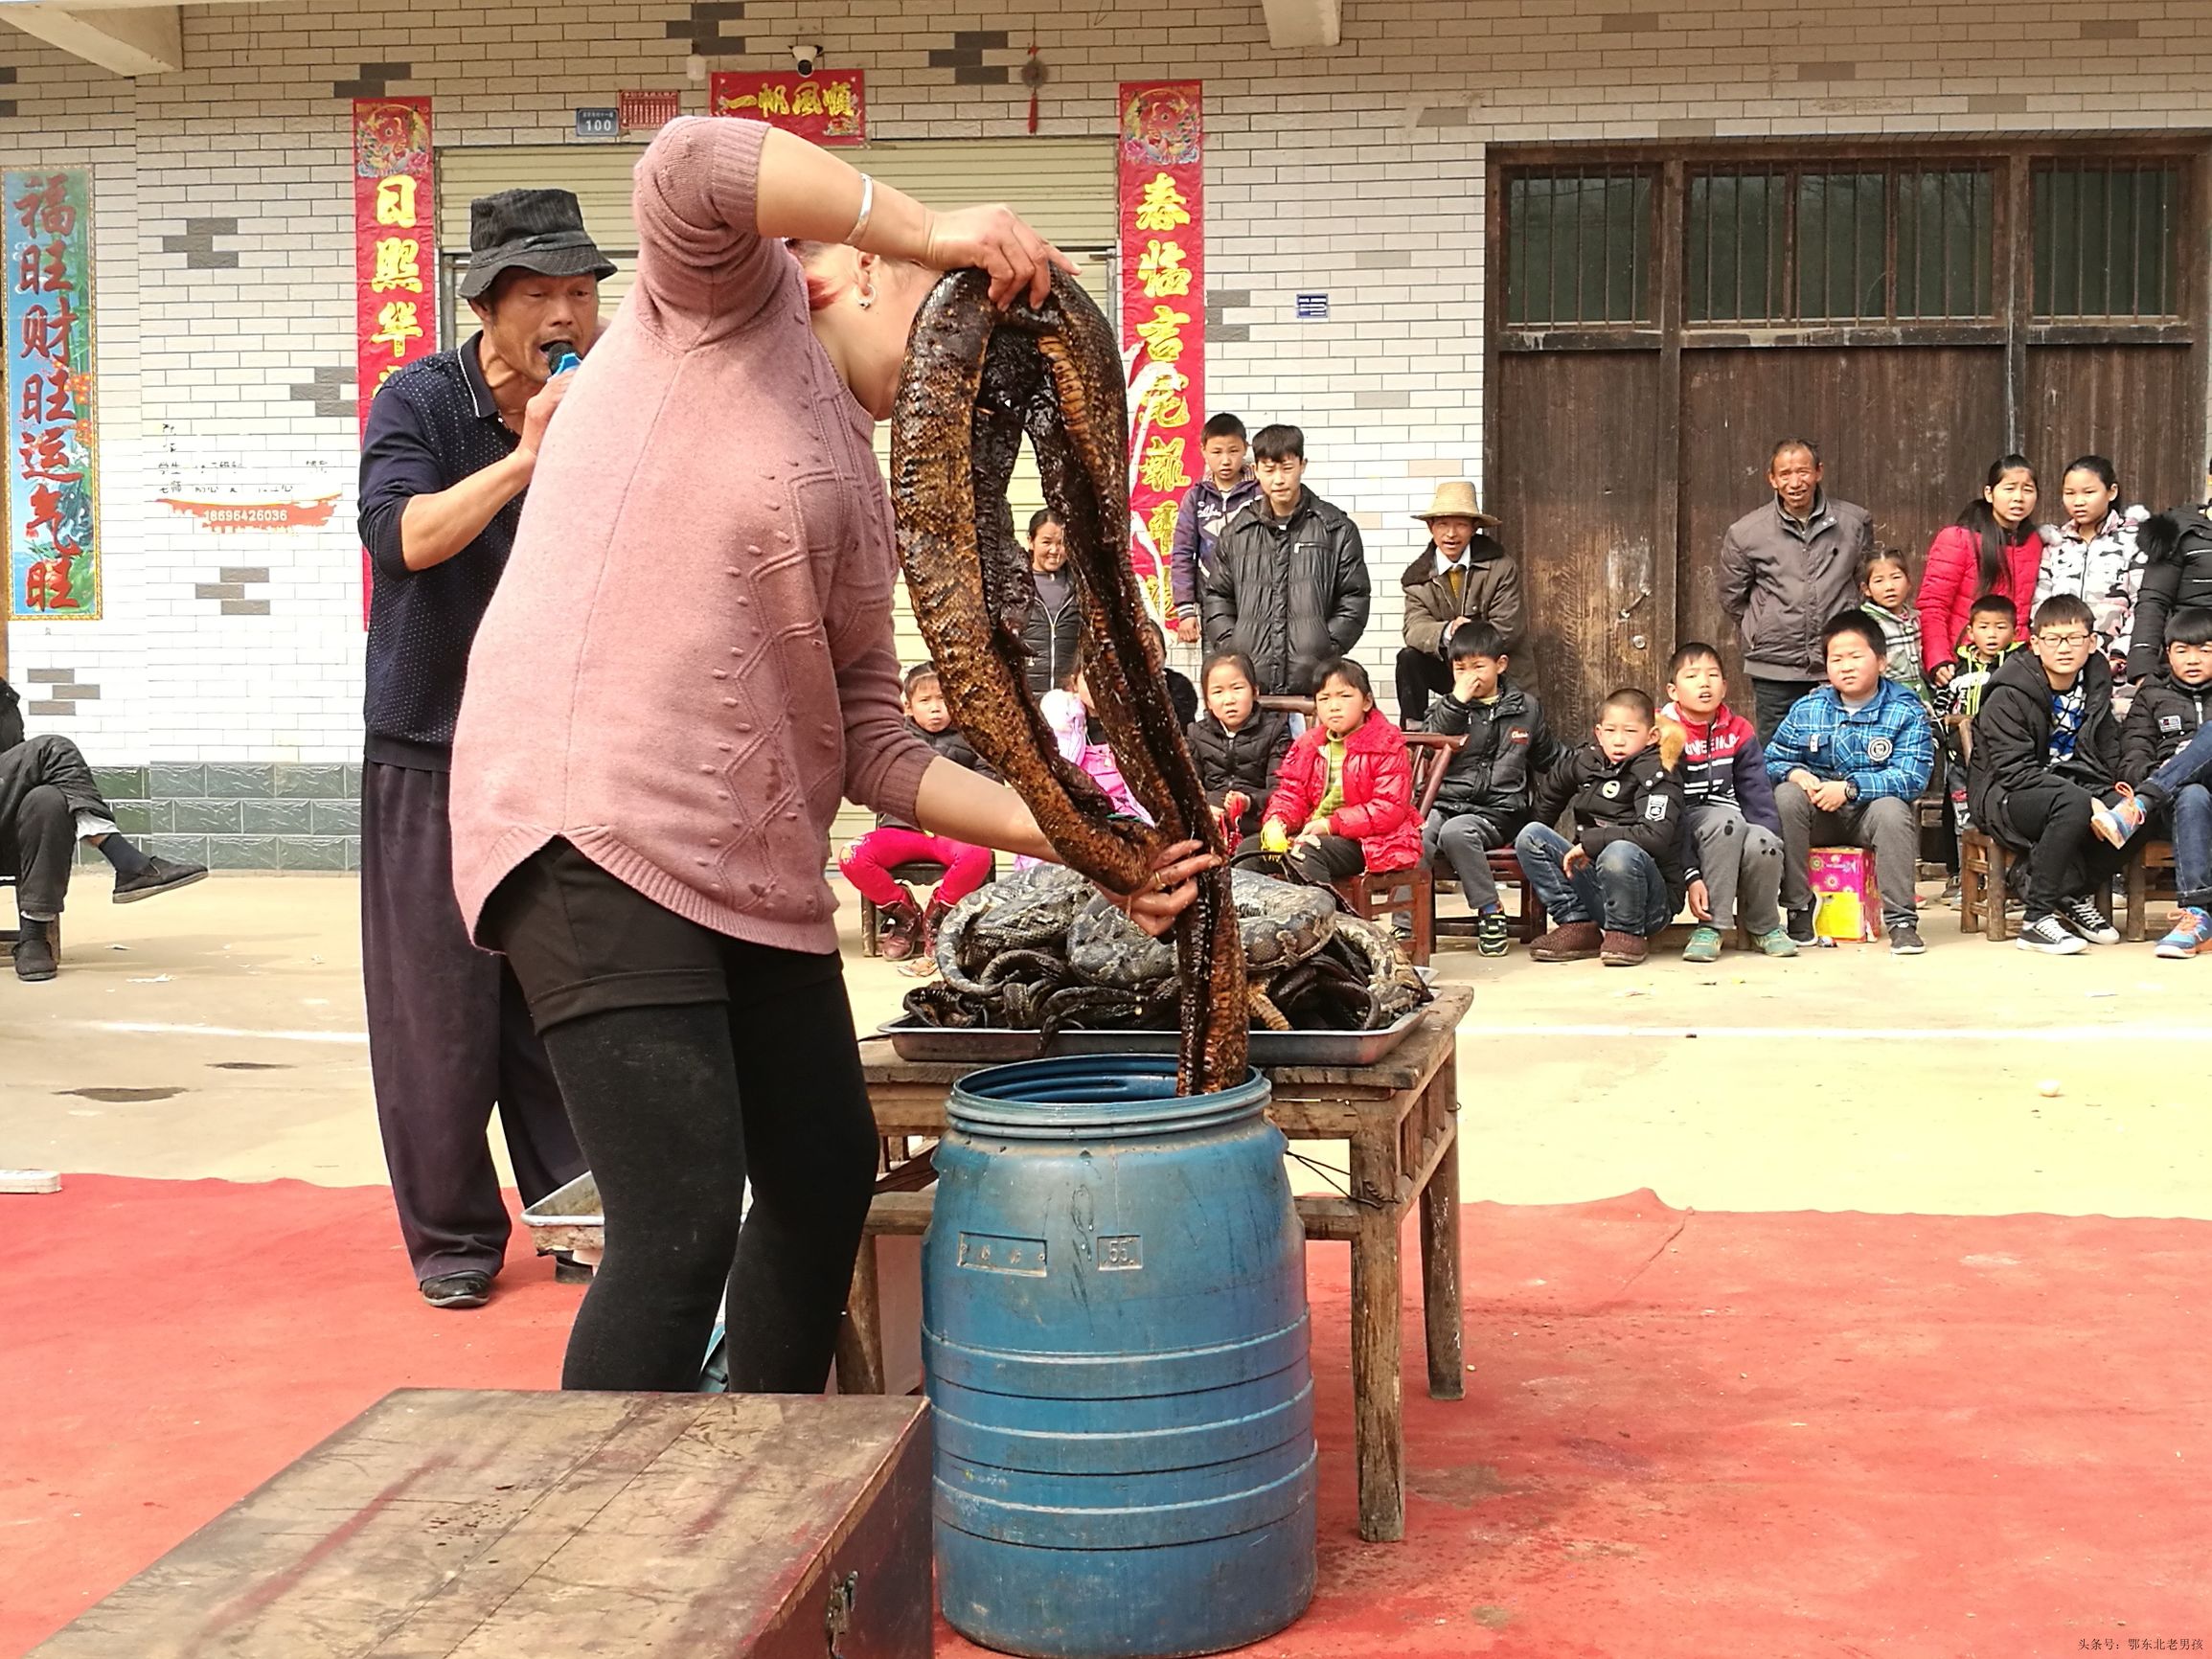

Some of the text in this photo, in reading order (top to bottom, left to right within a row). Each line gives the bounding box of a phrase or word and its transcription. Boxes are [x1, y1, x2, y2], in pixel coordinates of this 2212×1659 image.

[585, 119, 611, 131] 100
[12, 174, 83, 613] 福旺财旺运气旺
[370, 174, 424, 398] 日照华
